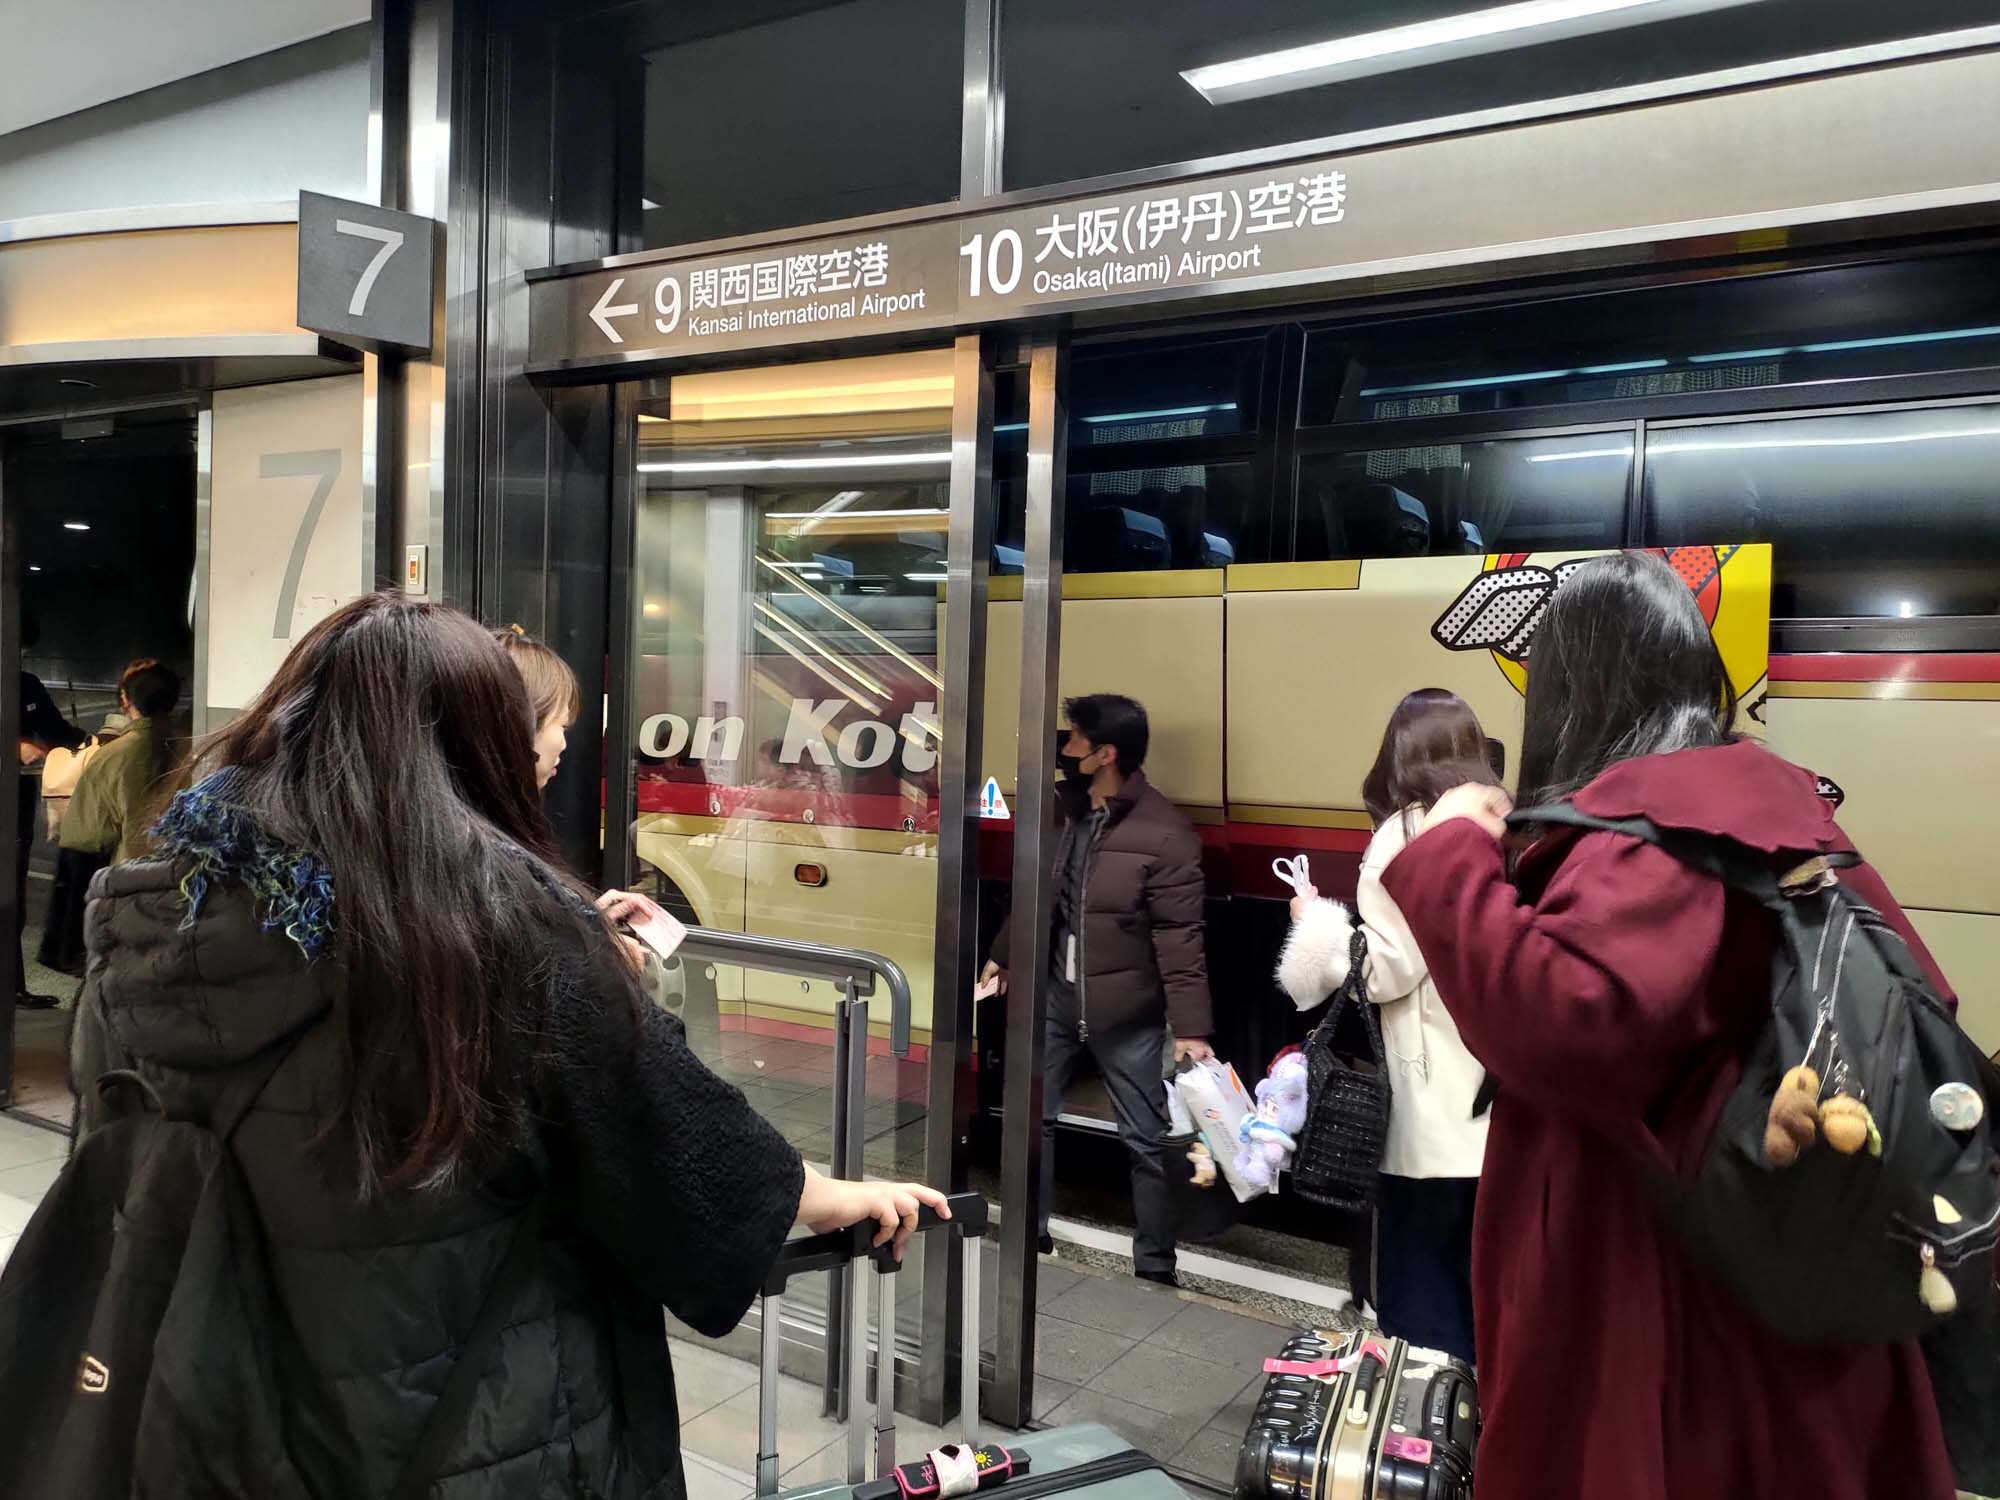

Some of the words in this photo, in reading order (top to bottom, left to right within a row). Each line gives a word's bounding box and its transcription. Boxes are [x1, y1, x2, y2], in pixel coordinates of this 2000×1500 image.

[1034, 171, 1348, 263] 大阪(伊丹)空港
[336, 219, 405, 317] 7
[687, 242, 890, 312] 関西国際空港
[960, 229, 1024, 298] 10
[1032, 257, 1172, 294] Osaka(Itami)
[1178, 244, 1261, 279] Airport
[654, 277, 683, 335] 9
[688, 312, 744, 337] Kansai
[748, 296, 856, 330] International
[860, 288, 926, 320] Airport
[259, 448, 342, 640] 7
